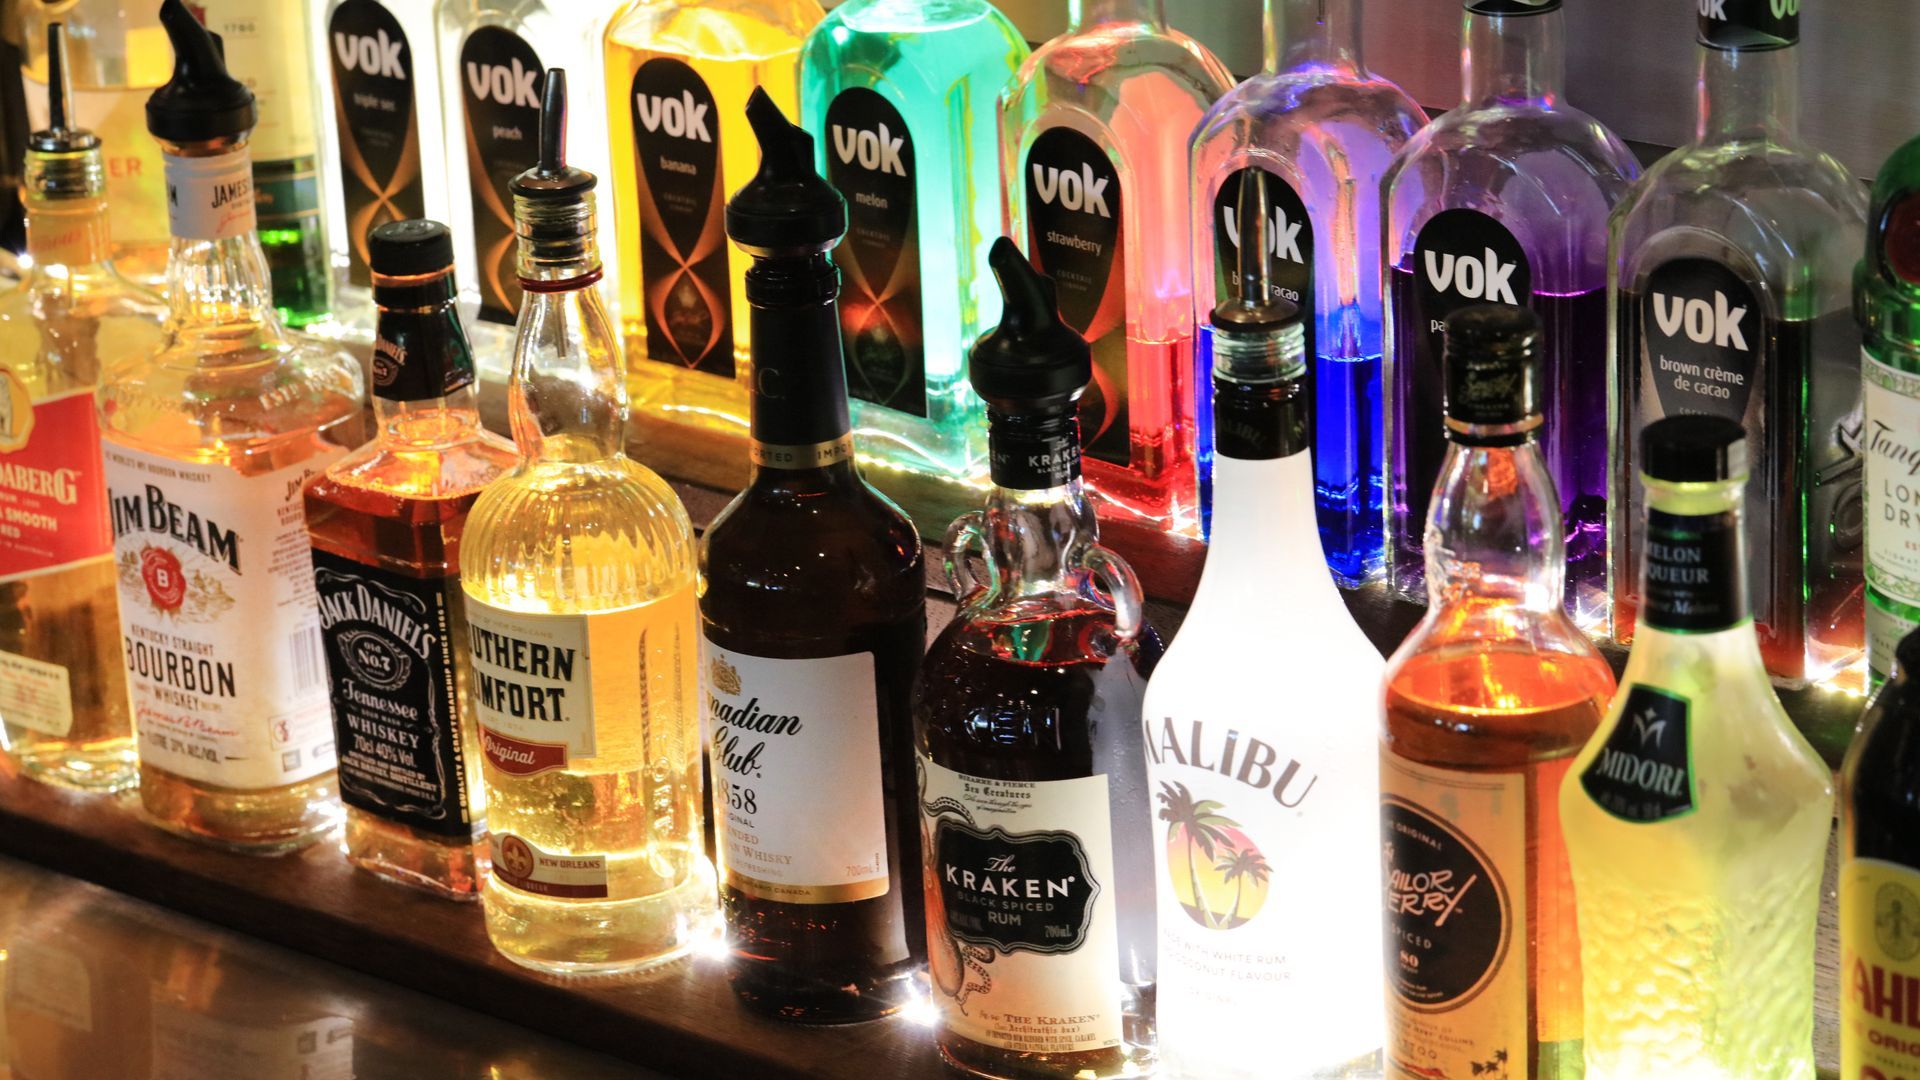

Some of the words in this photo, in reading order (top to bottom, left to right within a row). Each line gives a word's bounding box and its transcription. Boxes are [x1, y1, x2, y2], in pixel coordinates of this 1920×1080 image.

[334, 28, 406, 80] vok
[467, 57, 541, 109] vok
[636, 89, 712, 143] vok
[832, 122, 907, 177] vok
[660, 155, 697, 176] banana
[855, 191, 888, 209] melon
[1033, 162, 1111, 219] vok
[1046, 230, 1102, 257] strawberry
[1423, 247, 1518, 305] vok
[1652, 290, 1749, 351] vok
[1659, 354, 1700, 377] brown
[1704, 362, 1745, 386] crème
[1674, 373, 1690, 392] de
[1694, 380, 1731, 400] cacao
[144, 483, 242, 575] BEAM
[156, 567, 169, 588] B
[316, 591, 361, 630] JACK
[356, 584, 437, 660] DANIEL'S
[131, 624, 170, 645] KENTUCKY
[172, 635, 214, 657] STRAIGHT
[440, 634, 451, 665] SINCE
[125, 636, 236, 698] BOURBON
[154, 684, 199, 712] WHISKEY
[341, 677, 419, 721] Tennessee
[444, 667, 461, 753] CRAFTSMANSHIP
[346, 713, 420, 749] WHISKEY
[484, 735, 537, 765] Original
[455, 764, 467, 807] QUALITY
[1596, 747, 1685, 797] MIDORI
[964, 783, 980, 794] Sea
[983, 786, 1032, 799] Creatures
[540, 857, 558, 868] NEW
[559, 858, 601, 870] ORLEANS
[743, 845, 793, 866] WHISKY
[983, 853, 1017, 873] The
[773, 886, 812, 896] CANADA
[957, 889, 997, 908] BLACK
[1002, 900, 1055, 912] SPICED
[987, 911, 1022, 926] RUM
[1391, 924, 1433, 950] SPICED
[1213, 951, 1252, 965] WHITE
[1256, 955, 1287, 966] RUM
[1230, 969, 1292, 983] FLAVOUR
[1003, 1012, 1032, 1025] THE
